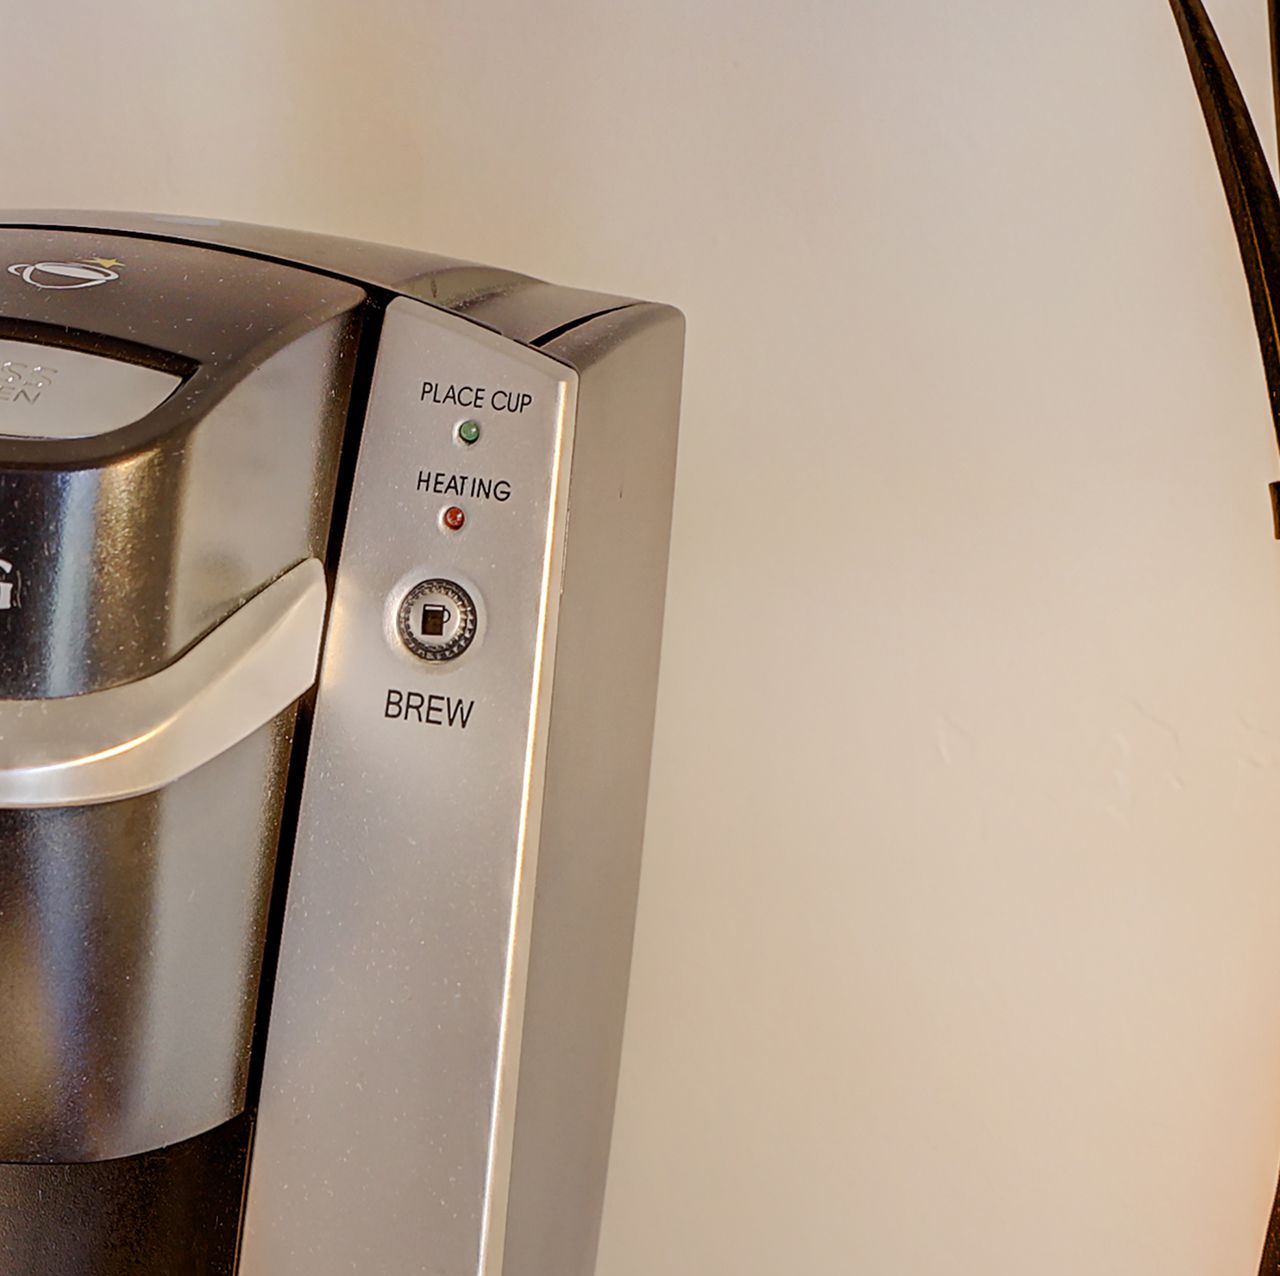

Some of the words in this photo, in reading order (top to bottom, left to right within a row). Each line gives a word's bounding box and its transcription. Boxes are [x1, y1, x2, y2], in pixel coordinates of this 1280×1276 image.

[420, 382, 484, 409] PLACE
[491, 390, 532, 413] CUP
[416, 470, 511, 502] HEATING
[384, 689, 474, 729] BREW
